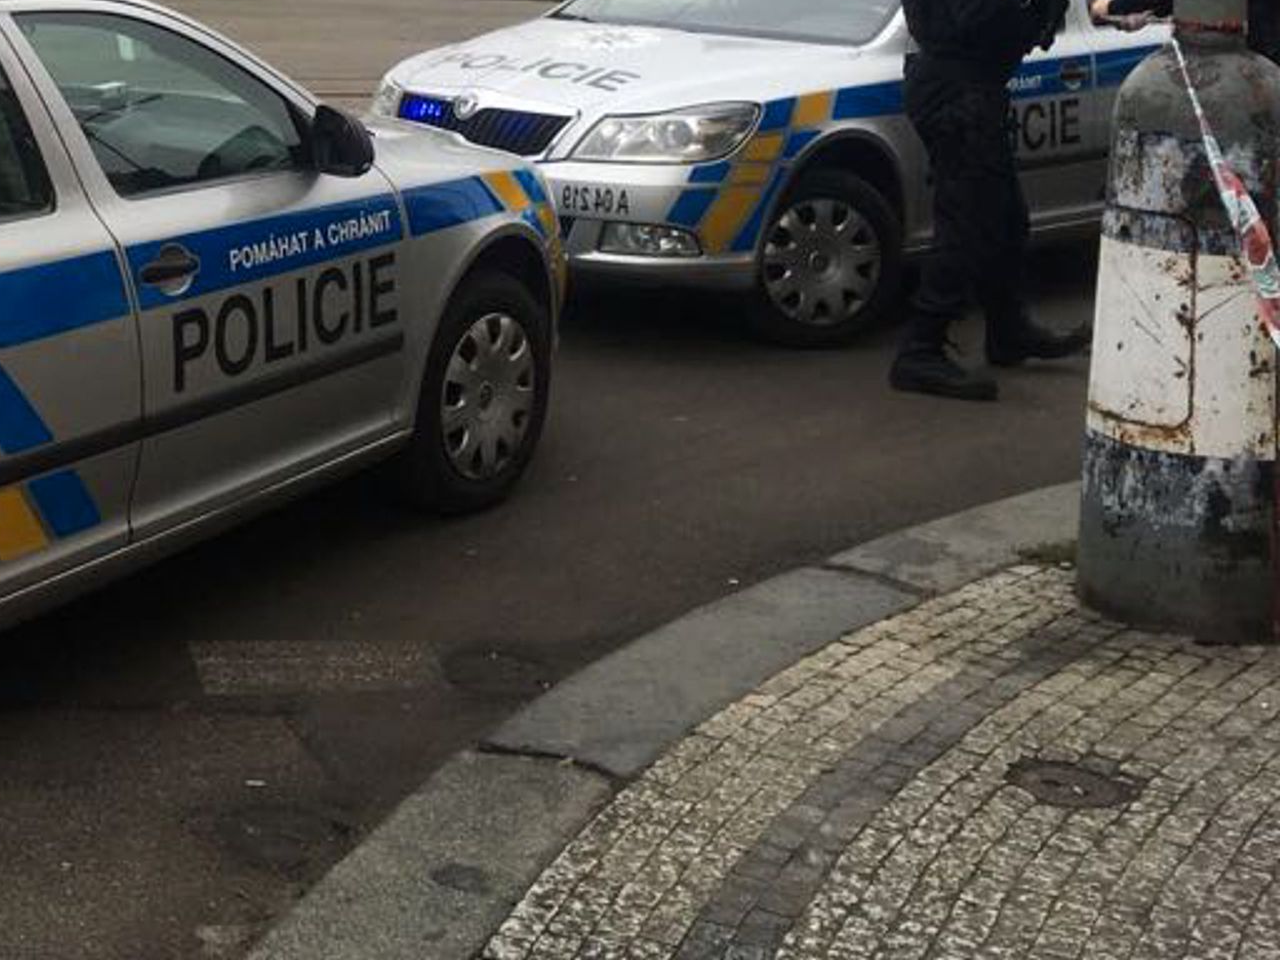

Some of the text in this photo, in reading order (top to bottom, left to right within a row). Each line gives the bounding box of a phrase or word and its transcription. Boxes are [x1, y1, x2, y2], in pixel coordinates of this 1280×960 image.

[429, 54, 641, 91] POLICIE
[229, 210, 390, 271] POMÁHAT A CHRÁNIT
[173, 252, 398, 392] POLICIE
